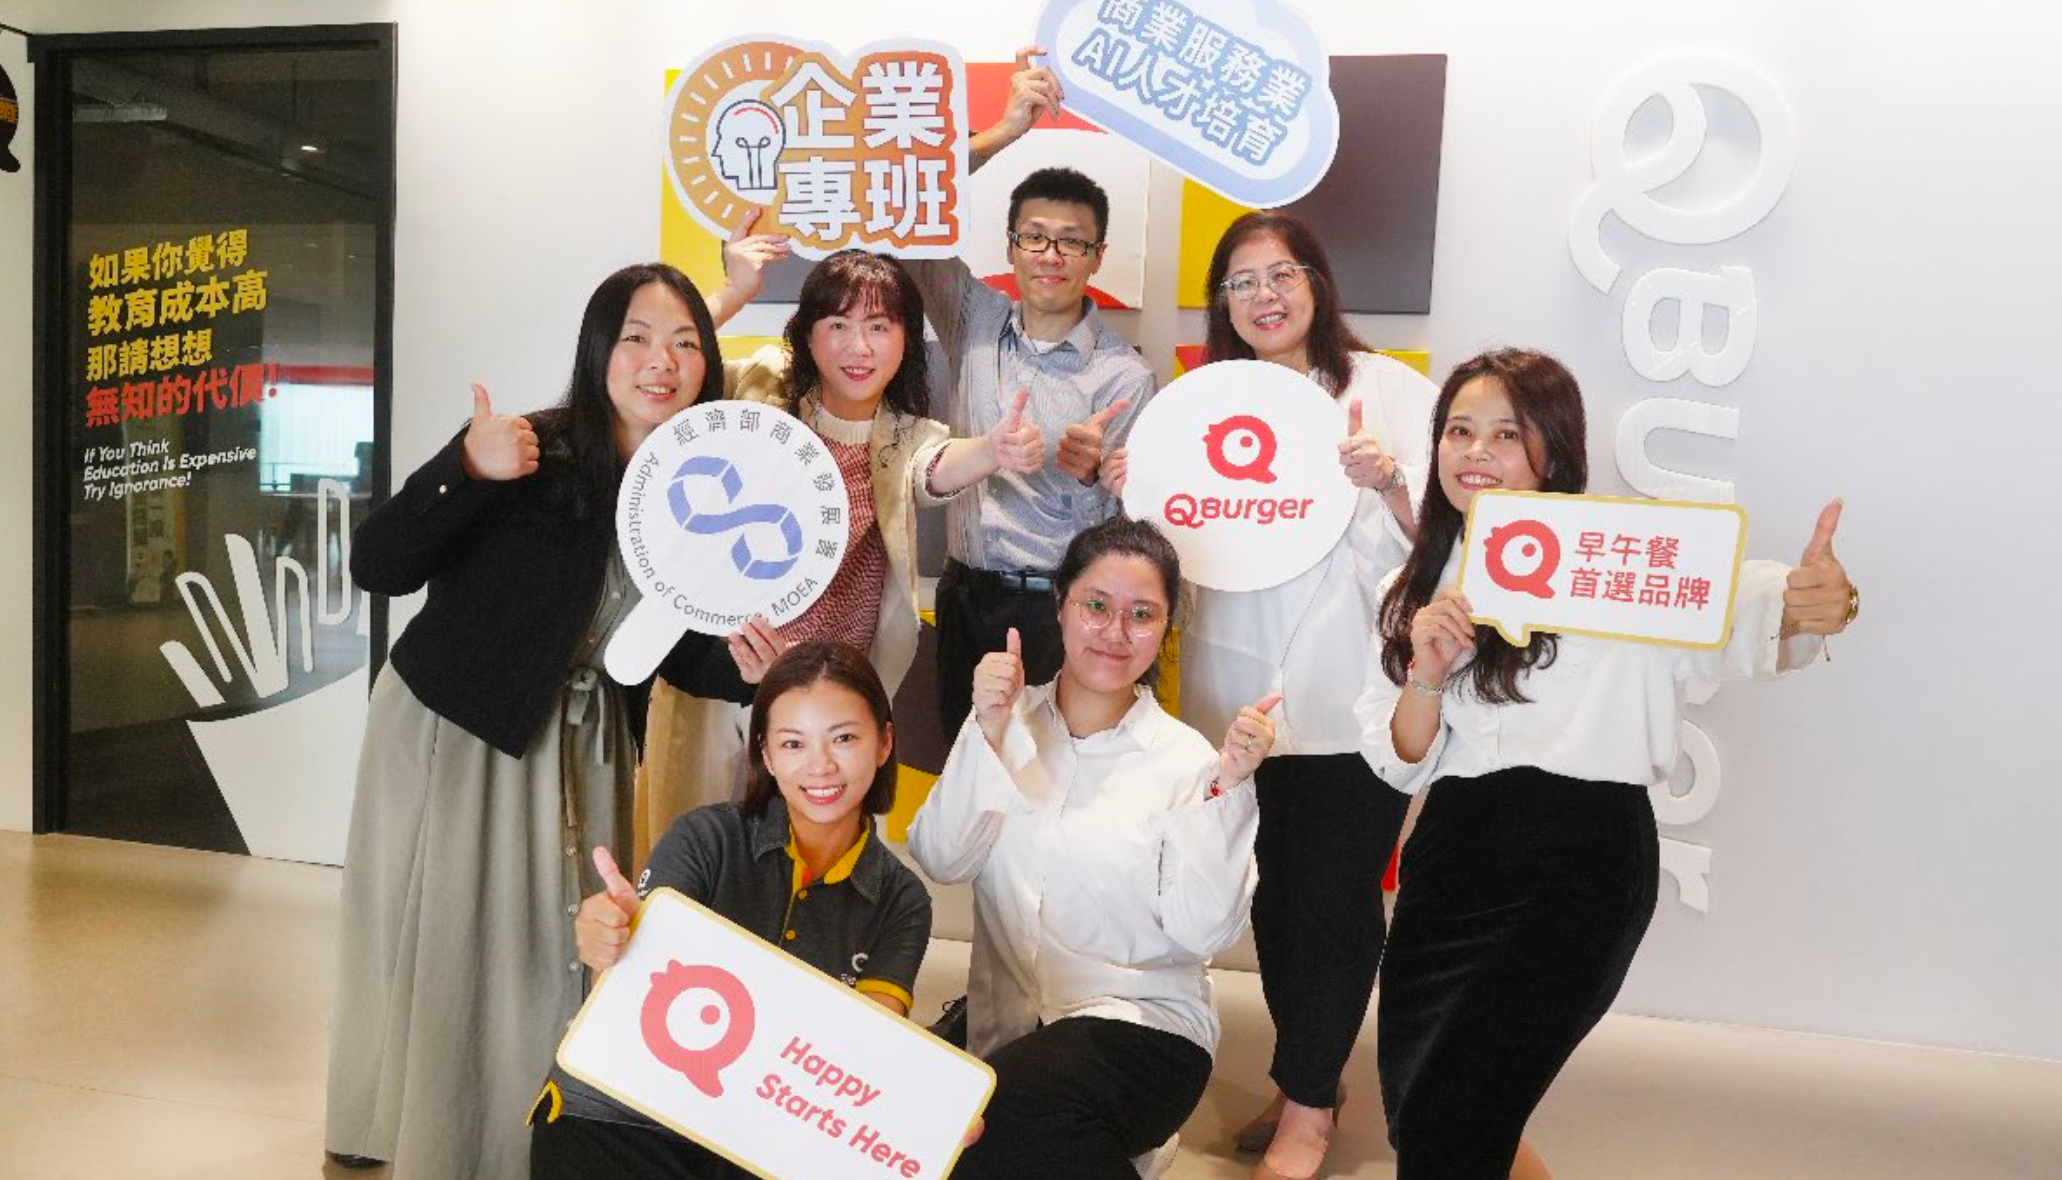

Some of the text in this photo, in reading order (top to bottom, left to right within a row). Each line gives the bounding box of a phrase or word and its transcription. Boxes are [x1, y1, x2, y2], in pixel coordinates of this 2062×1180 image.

[769, 60, 949, 149] 企業
[1079, 32, 1281, 162] AI人才培育
[777, 156, 951, 241] 專班
[89, 229, 248, 290] 如果你覺得
[87, 269, 268, 337] 教育成本高
[86, 328, 213, 382] 那請想想
[86, 363, 280, 428] 無知的代價!
[83, 446, 257, 482] Education Is Expensive
[84, 438, 171, 464] If You Think
[672, 408, 841, 559] 經濟部商業發展署
[83, 471, 192, 501] Try Ignorance!
[1163, 493, 1314, 530] QBurger
[628, 451, 660, 580] Administration
[654, 579, 676, 598] of
[771, 576, 818, 617] MOEA
[1574, 531, 1680, 570] 早午餐
[1570, 567, 1712, 611] 首選品牌
[779, 1035, 882, 1108] Happy
[755, 1073, 922, 1180] Starts Here
